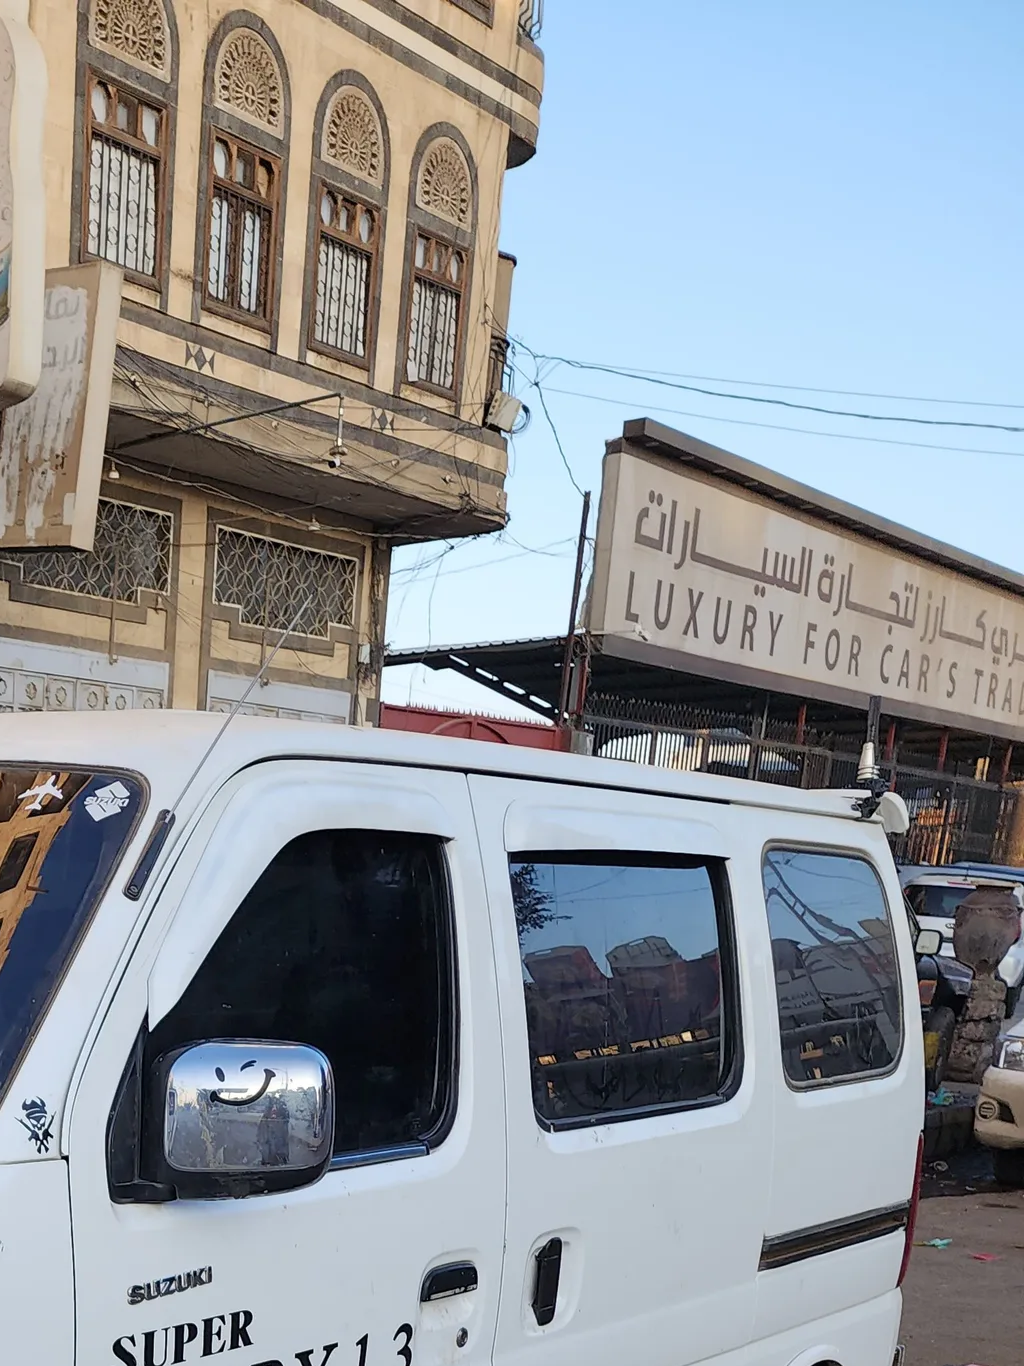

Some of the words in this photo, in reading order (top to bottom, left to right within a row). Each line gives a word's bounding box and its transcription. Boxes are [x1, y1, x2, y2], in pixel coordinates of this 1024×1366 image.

[634, 490, 813, 598] السيارات
[817, 553, 919, 635] لتجارة
[920, 590, 987, 649] كارز
[625, 570, 784, 657] LUXURY
[803, 621, 862, 677] FOR
[880, 644, 958, 699] CAR'S
[84, 796, 129, 808] SUZUKI
[127, 1265, 213, 1305] SUZUKI
